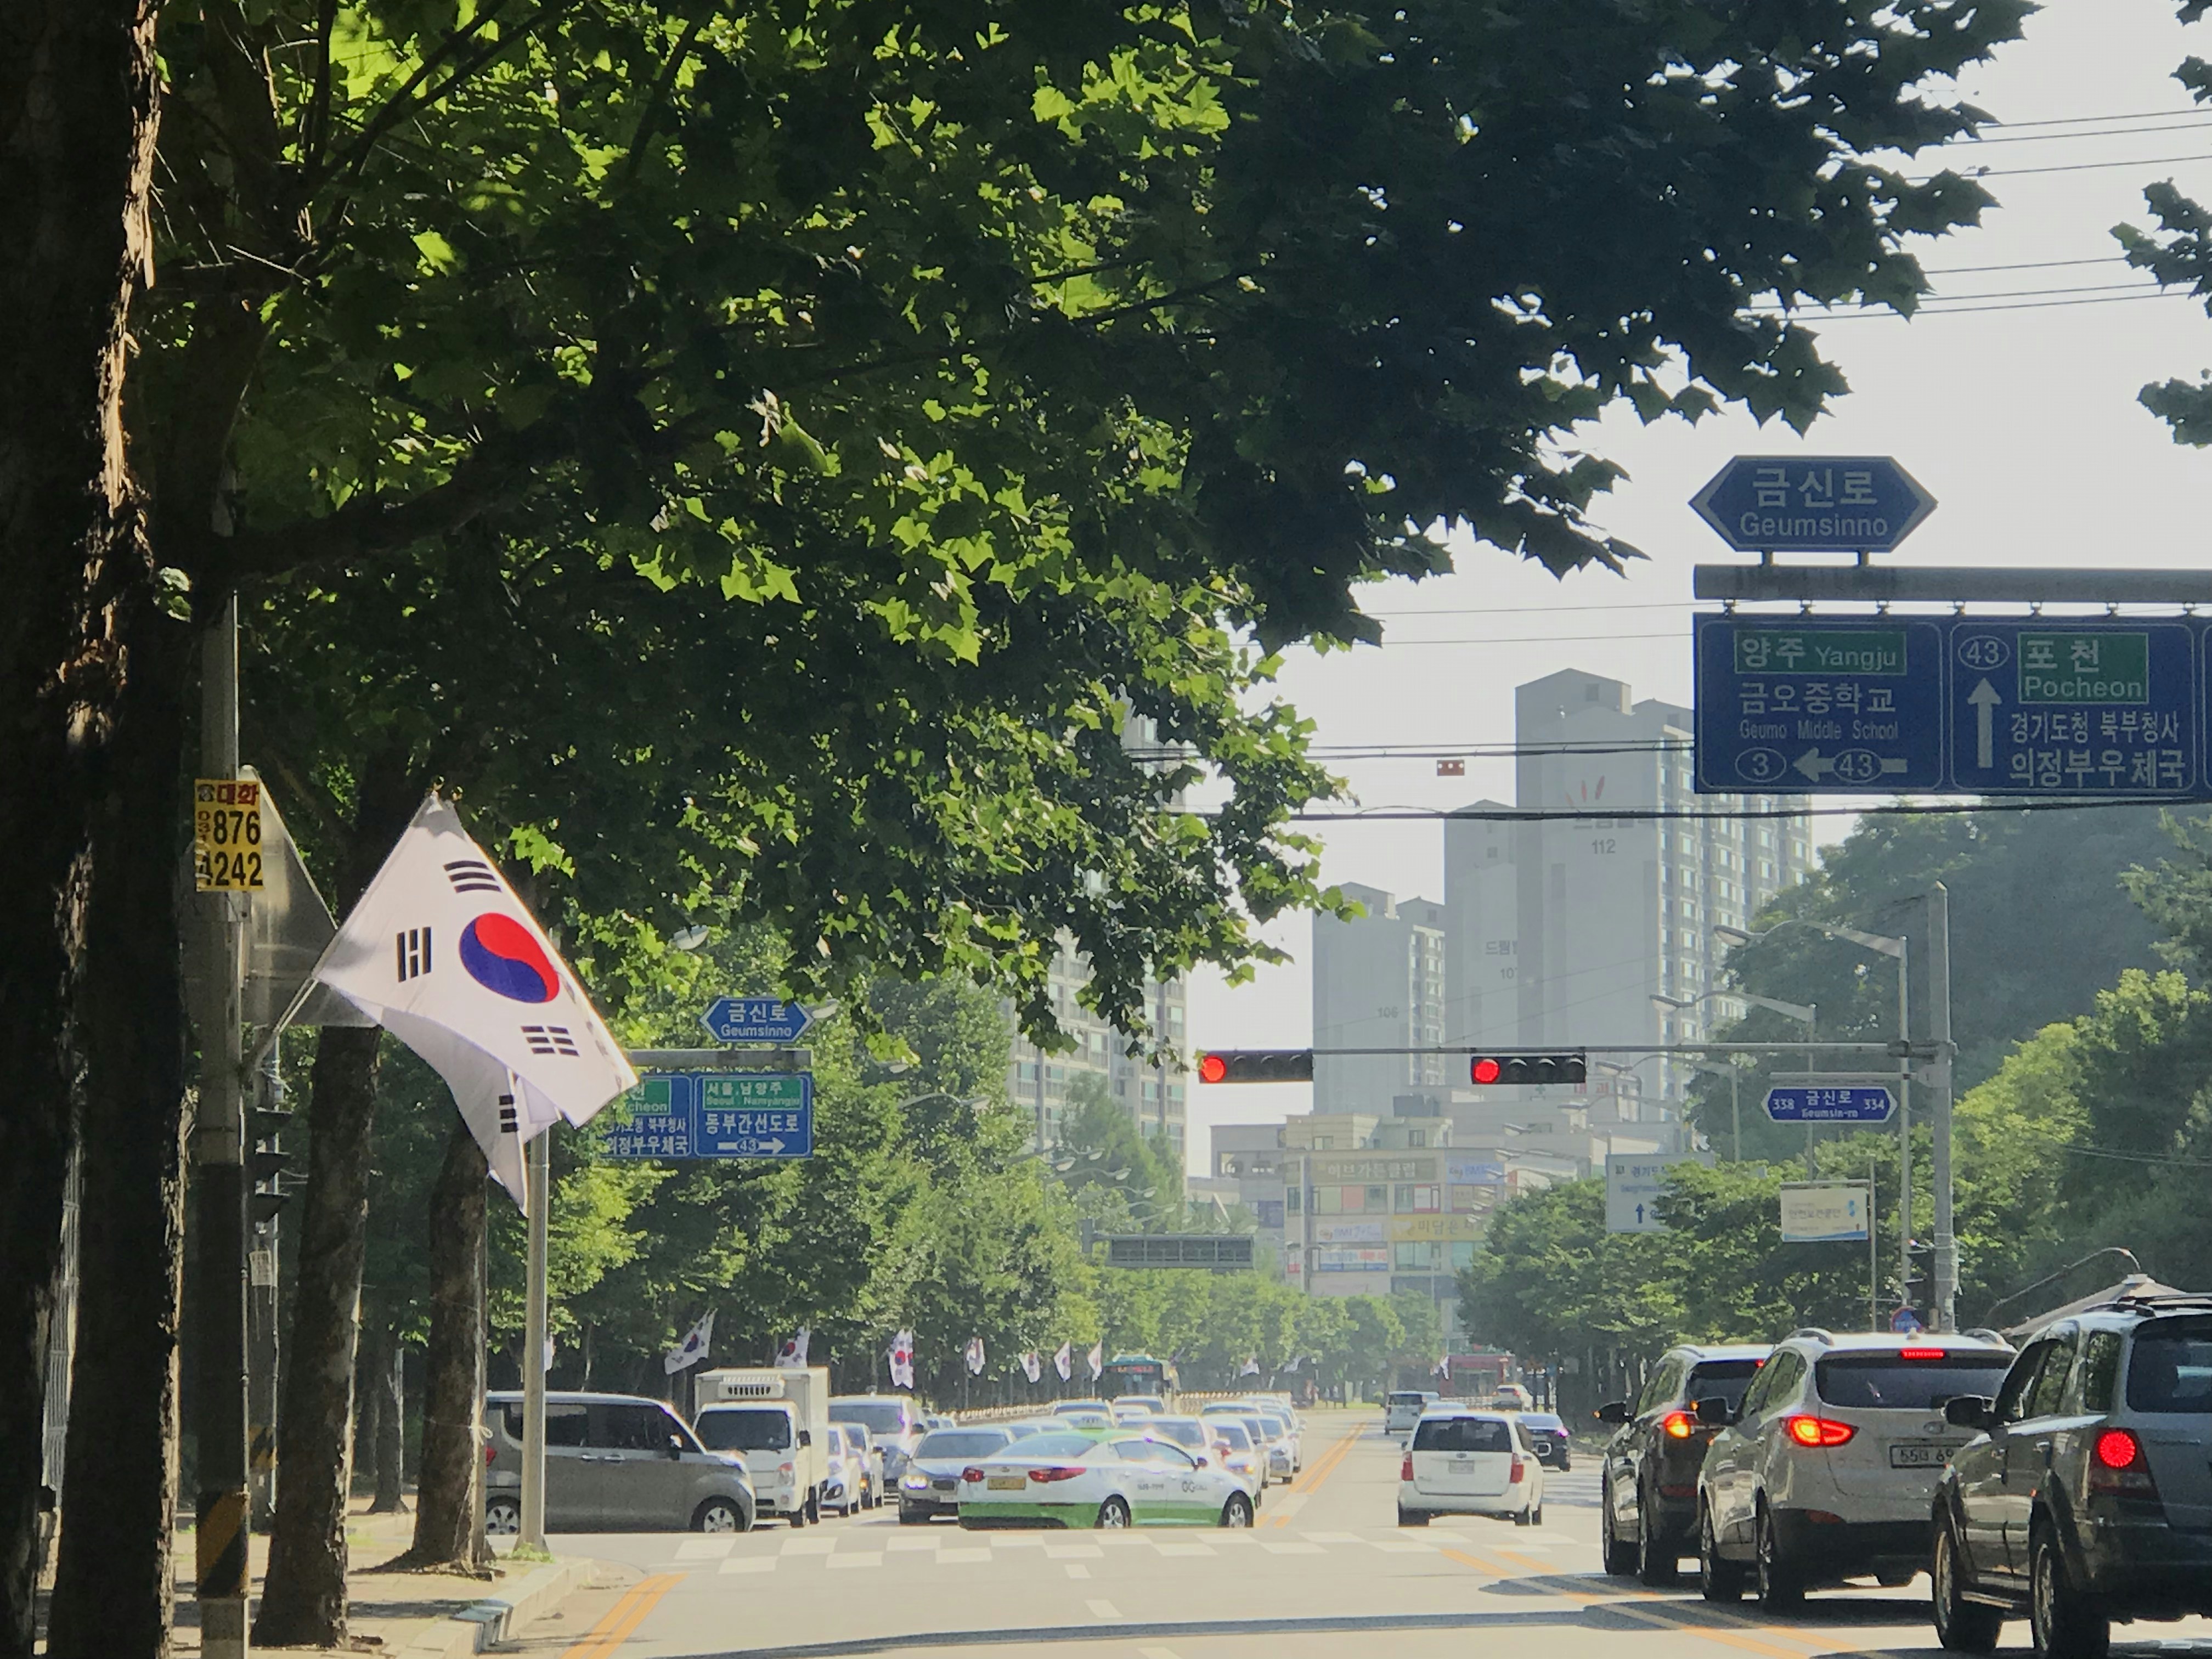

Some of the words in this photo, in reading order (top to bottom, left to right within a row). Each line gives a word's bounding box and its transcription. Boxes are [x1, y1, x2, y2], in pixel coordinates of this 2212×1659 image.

[1752, 468, 1877, 508] 금신로
[1740, 512, 1888, 537] Geumsinno
[1742, 637, 1806, 668] 양주
[1815, 646, 1896, 671] Yangju
[1966, 641, 2000, 664] 43
[2025, 640, 2100, 673] 포천
[2025, 676, 2142, 698] Pocheon
[1739, 682, 1895, 715] 금오중학교
[1740, 720, 1787, 740] Geumo
[1798, 720, 1842, 740] Middle
[1852, 720, 1899, 740] School
[2011, 712, 2089, 744] 경기도청
[2100, 711, 2180, 743] 북부청사
[1753, 753, 1768, 776] 3
[1838, 755, 1874, 777] 43
[2010, 748, 2186, 788] 의정부우체국
[217, 783, 259, 805] 대화
[213, 809, 261, 845] 876
[1592, 838, 1616, 854] 112
[1500, 967, 1517, 980] 10
[728, 1002, 788, 1024] 금신로
[720, 1024, 792, 1037] Geumsinno
[1805, 1090, 1853, 1106] 금신로
[706, 1113, 799, 1135] 동부간선도로
[740, 1140, 757, 1152] 43
